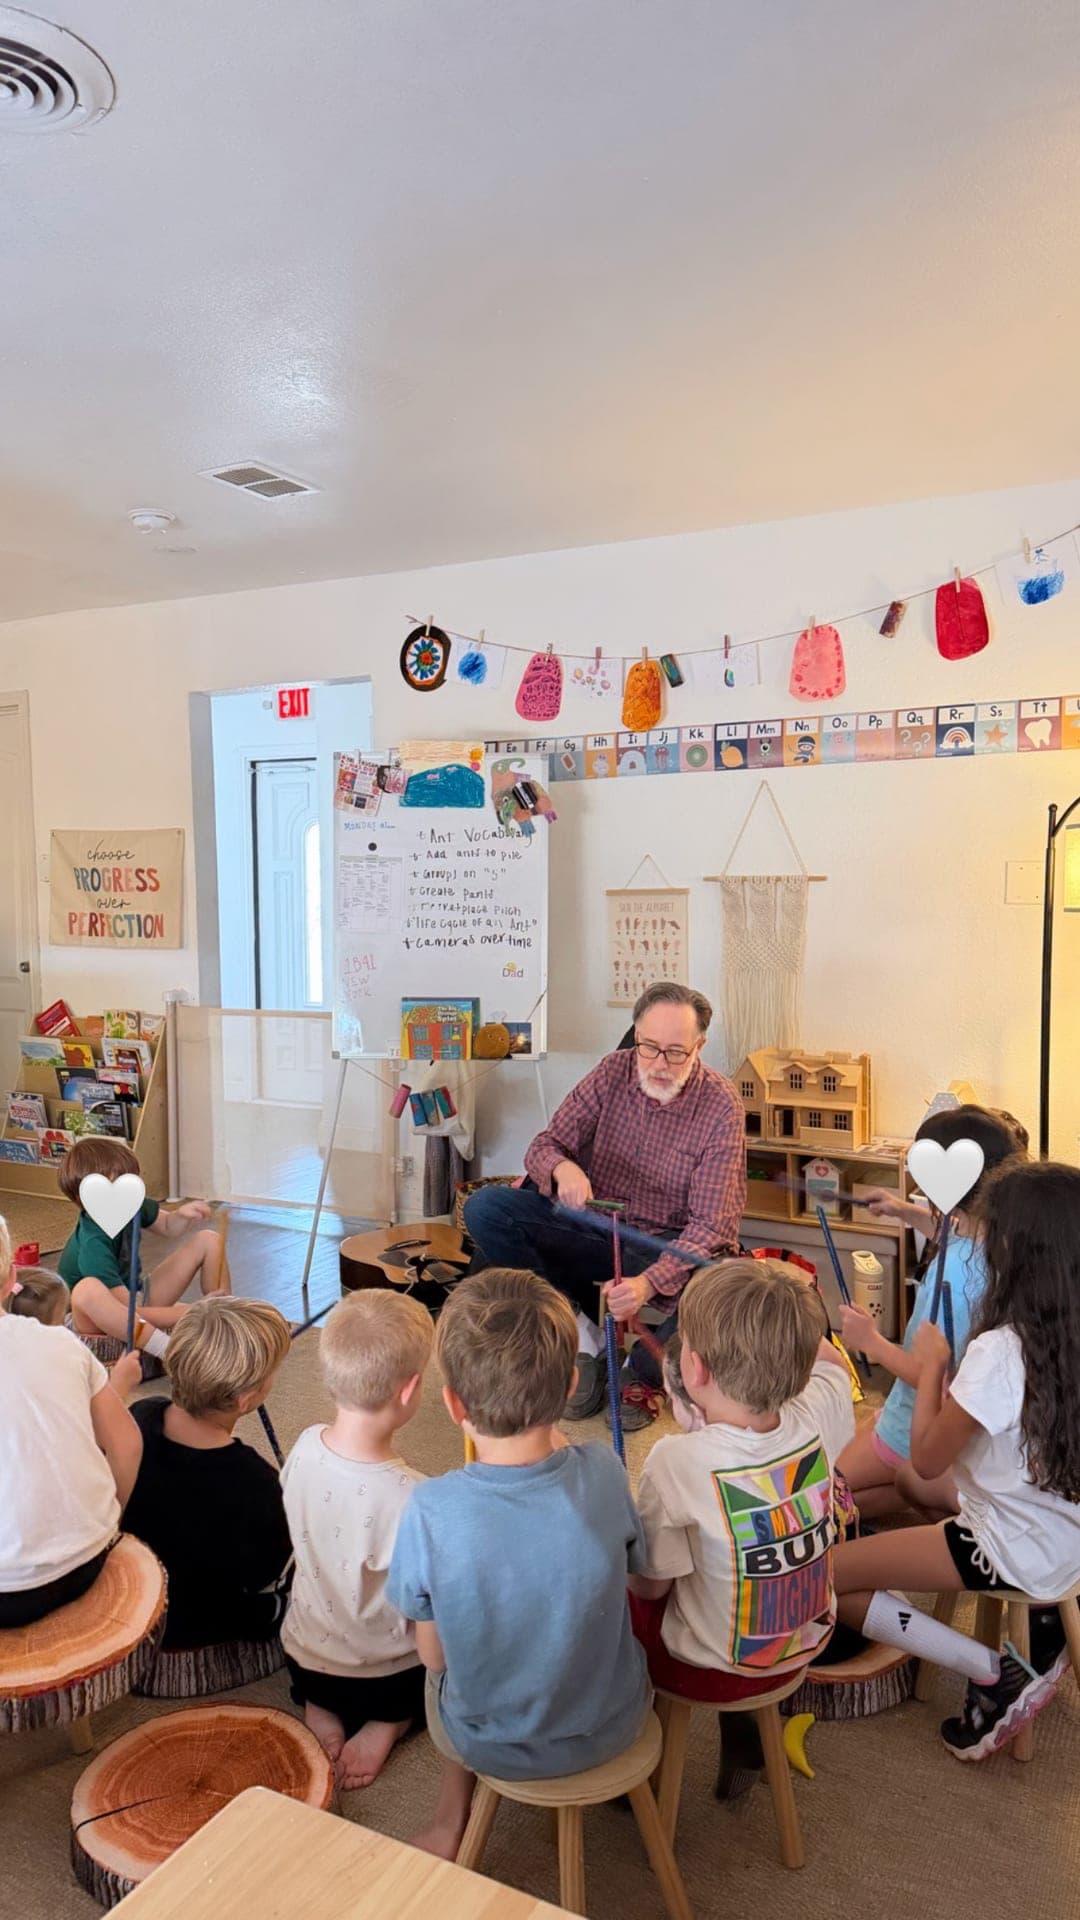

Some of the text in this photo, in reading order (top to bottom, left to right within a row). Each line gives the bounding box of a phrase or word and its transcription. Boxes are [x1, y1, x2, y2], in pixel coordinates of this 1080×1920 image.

[278, 687, 310, 719] EXIT
[536, 741, 548, 751] Ff
[564, 739, 576, 751] Gg
[593, 737, 607, 748] Hh
[628, 733, 638, 744] Ii
[659, 731, 669, 744] Jj
[689, 728, 704, 739] Kk
[756, 724, 776, 735] Mm
[795, 721, 810, 732] Nn
[832, 717, 848, 729] Oo
[868, 714, 883, 728] Pp
[907, 711, 924, 726] Qq
[949, 708, 964, 721] Rr
[990, 705, 1003, 717] Ss
[1033, 701, 1048, 714] Tt
[430, 828, 456, 843] Ant
[87, 839, 136, 862] choose
[73, 867, 161, 892] PROGRESS
[96, 896, 131, 909] over
[68, 912, 165, 938] PERFECTION
[745, 1514, 830, 1576] BUT
